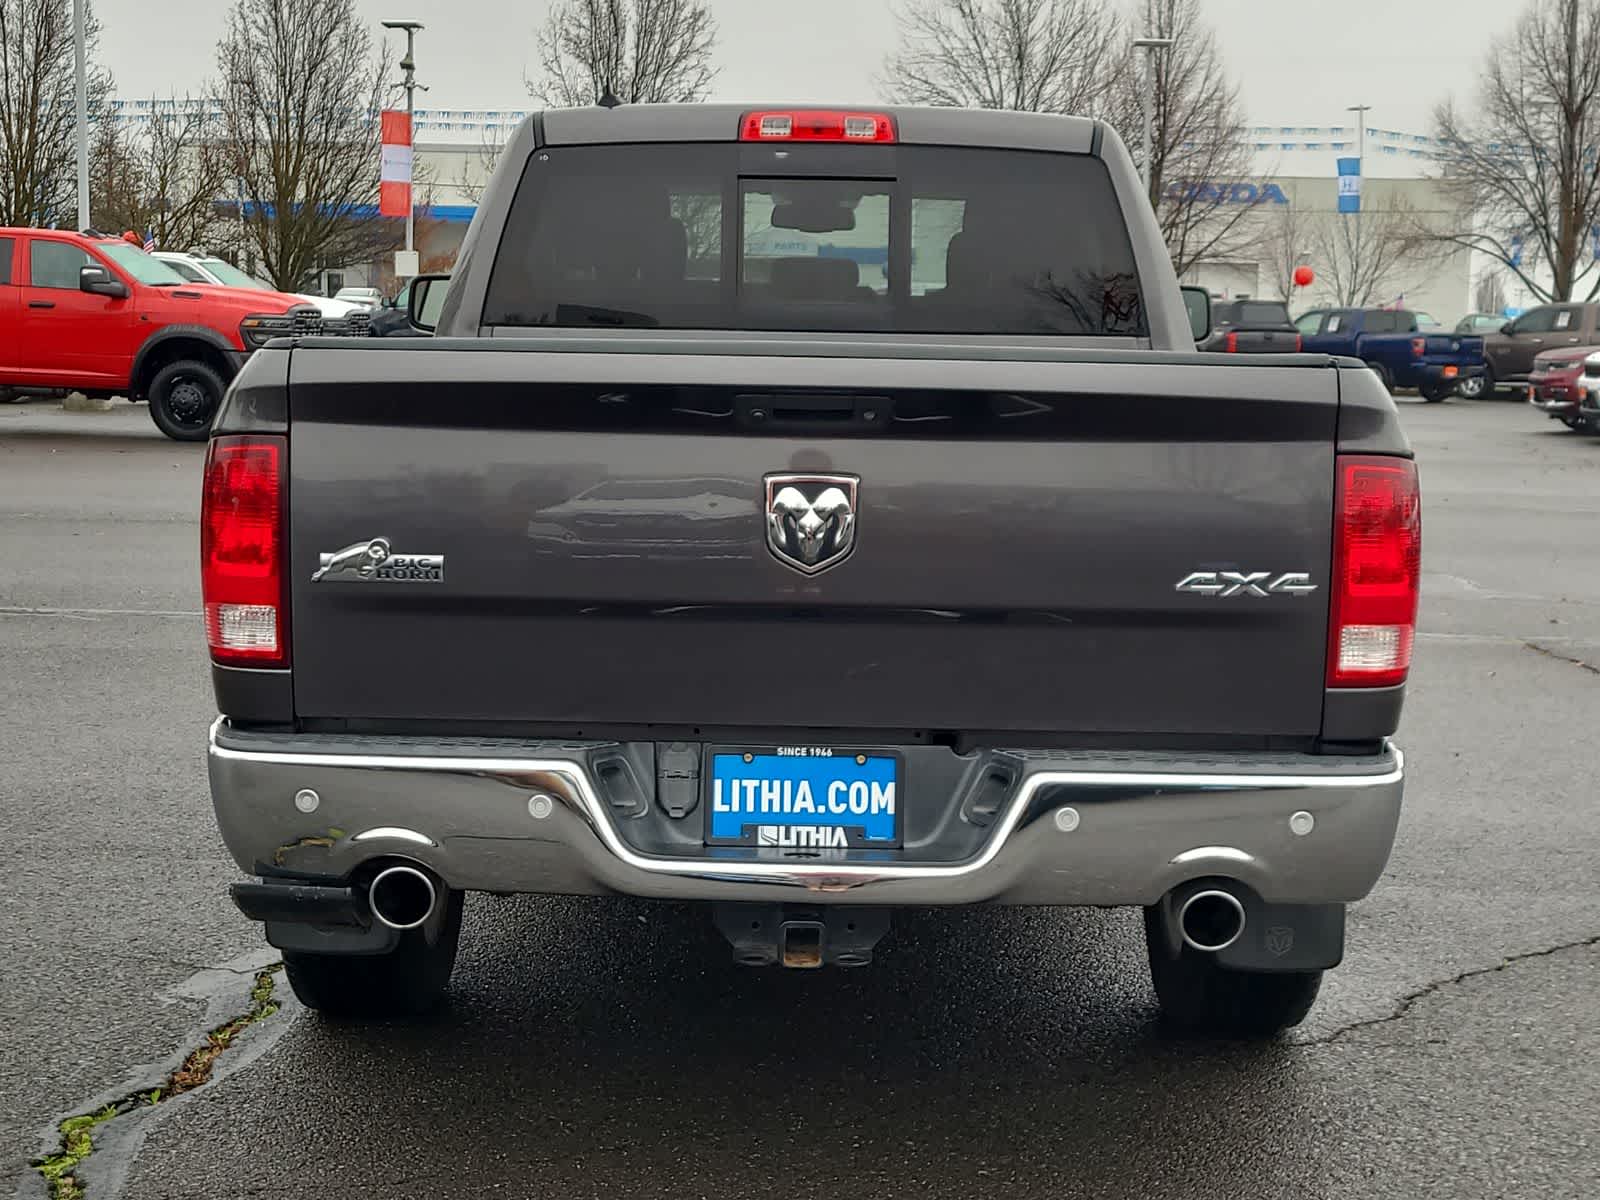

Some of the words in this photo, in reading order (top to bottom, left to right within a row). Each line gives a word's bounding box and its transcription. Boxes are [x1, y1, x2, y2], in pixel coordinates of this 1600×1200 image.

[1166, 182, 1290, 204] ONDA
[376, 569, 439, 579] HORN
[777, 747, 807, 756] SINCE
[809, 748, 833, 757] 1946
[713, 779, 896, 815] LITHIA.COM
[779, 826, 849, 847] LITHIA
